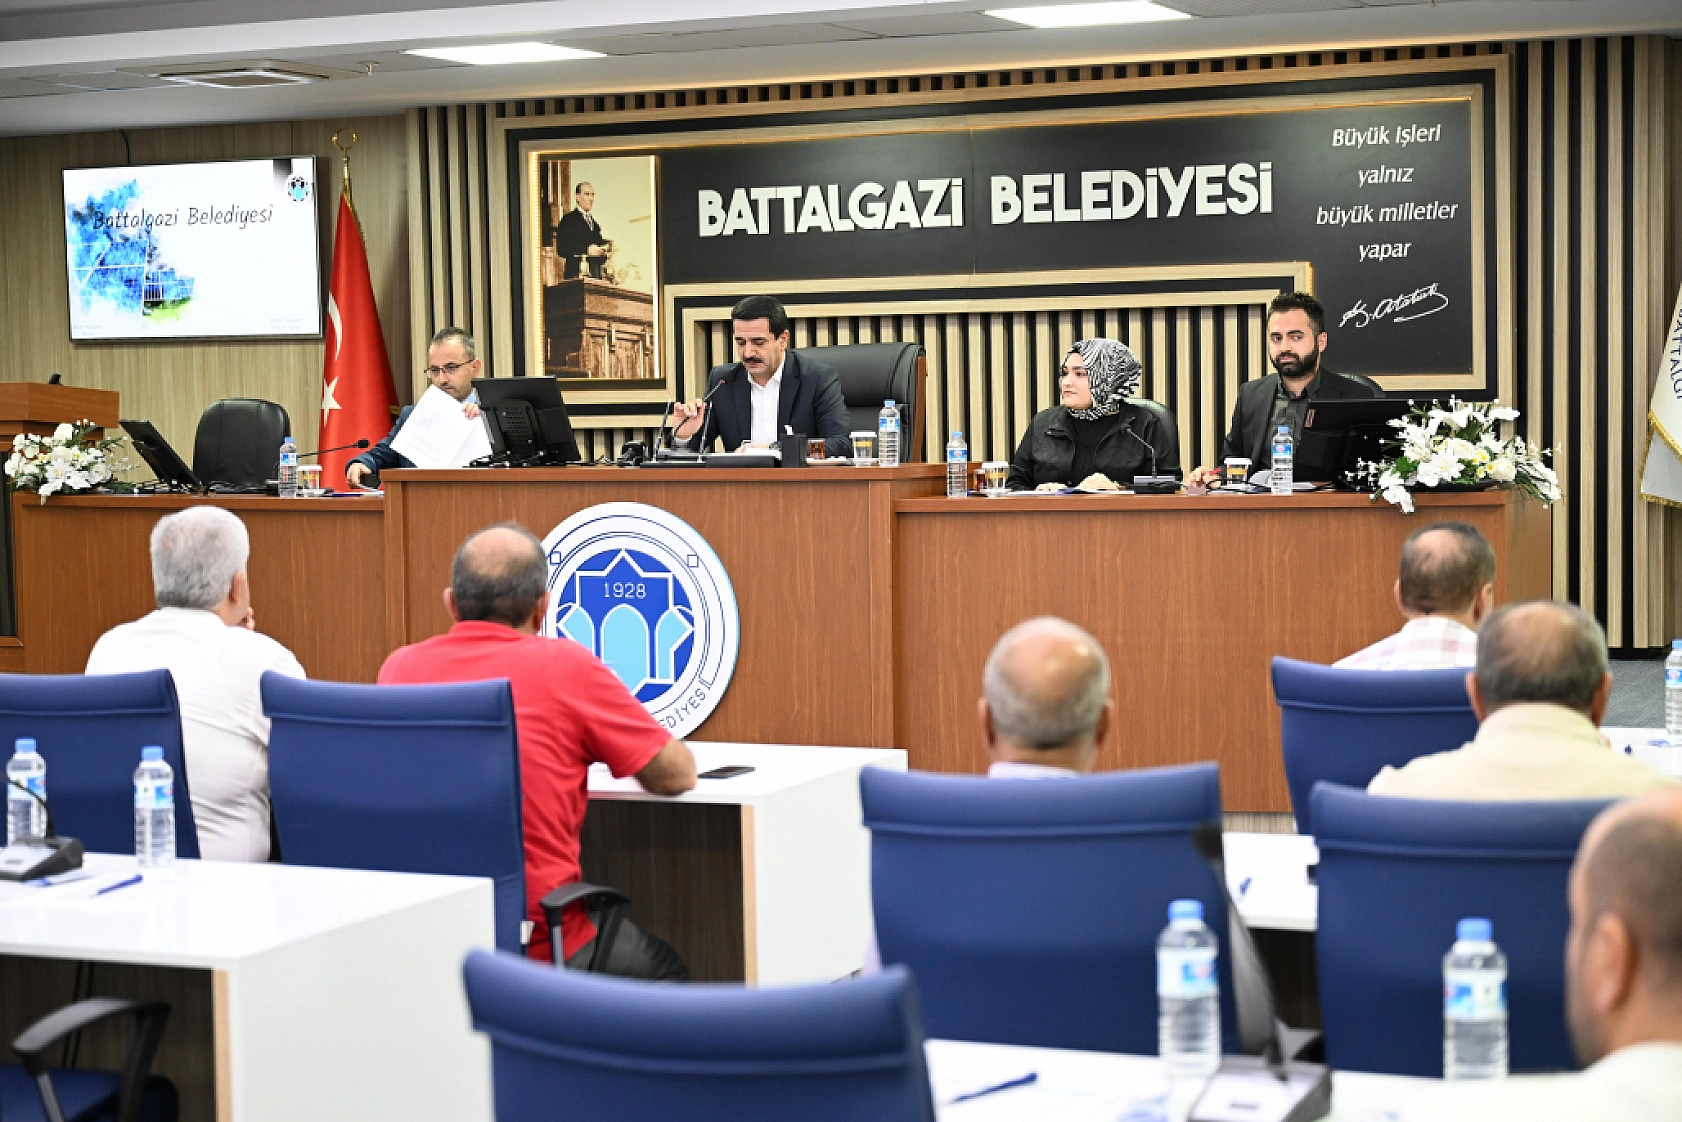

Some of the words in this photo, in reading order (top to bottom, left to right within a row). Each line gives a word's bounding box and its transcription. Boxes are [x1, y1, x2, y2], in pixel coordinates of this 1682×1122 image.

[1332, 125, 1389, 149] Büyük
[1395, 124, 1441, 148] işleri
[1357, 164, 1415, 188] yalnız
[94, 208, 179, 233] Battalgazi
[187, 204, 274, 230] Belediyesi
[1316, 204, 1374, 228] büyük
[1378, 201, 1459, 222] milletler
[1359, 242, 1413, 262] yapar
[604, 581, 647, 600] 1928
